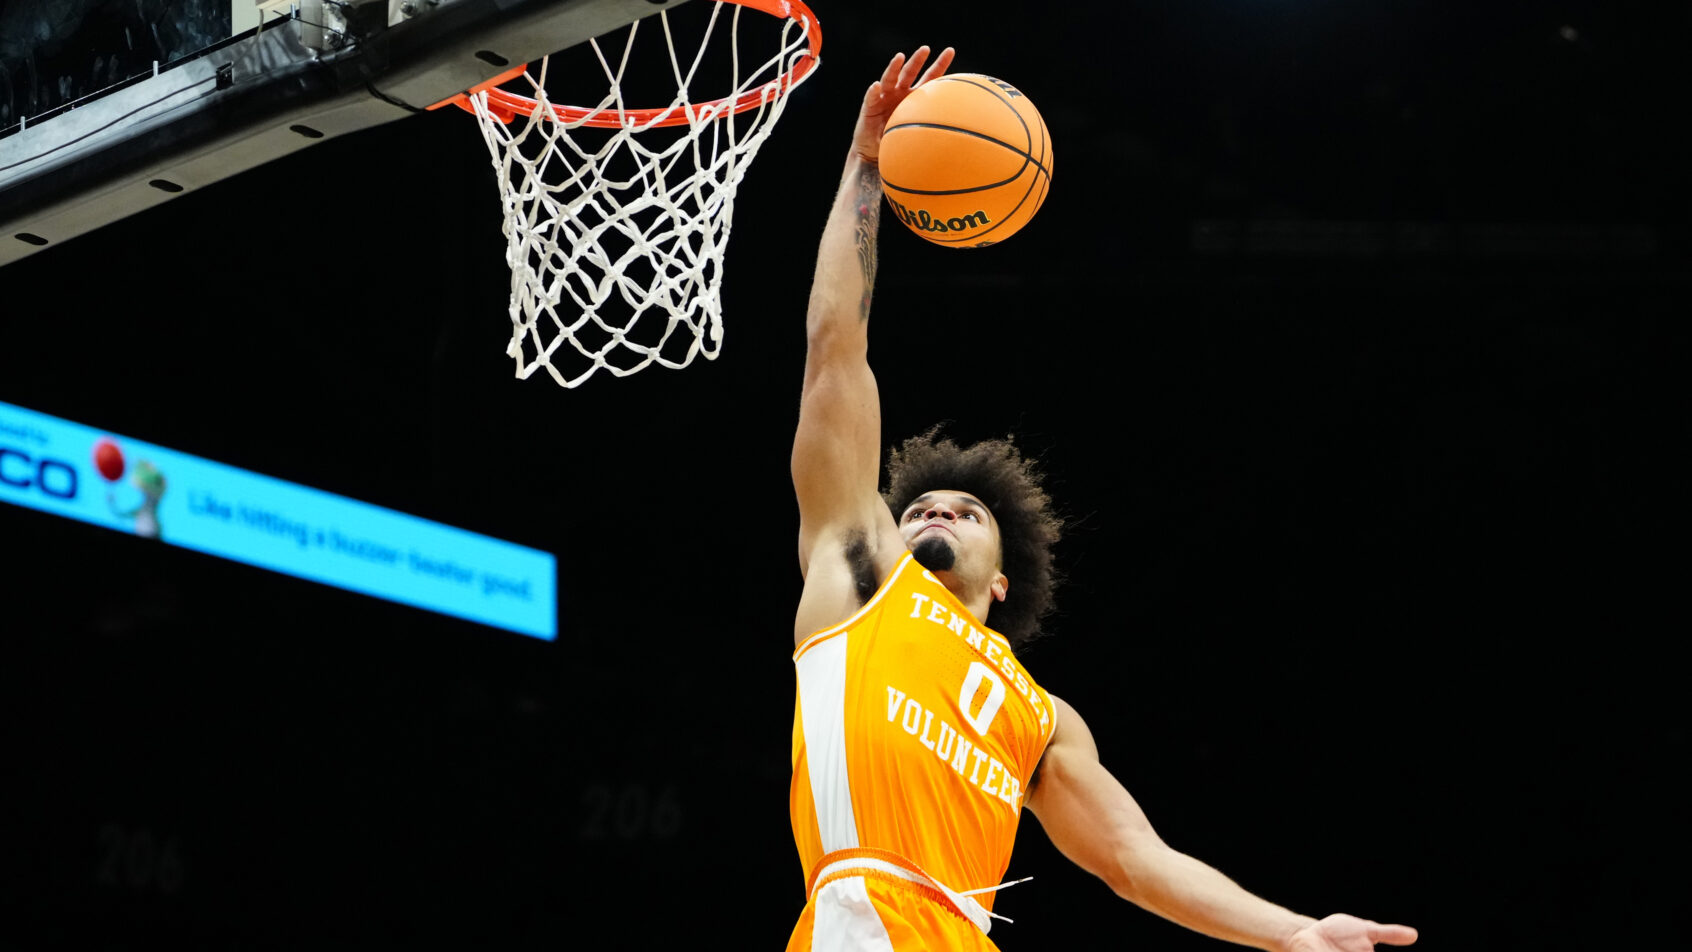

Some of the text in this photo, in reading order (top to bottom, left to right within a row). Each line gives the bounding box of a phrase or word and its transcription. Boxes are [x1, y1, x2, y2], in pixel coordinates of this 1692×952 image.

[187, 490, 232, 521] Like
[236, 502, 308, 547] hitting
[315, 529, 326, 545] a
[958, 660, 1007, 737] 0
[579, 784, 683, 840] 206
[97, 823, 184, 893] 206
